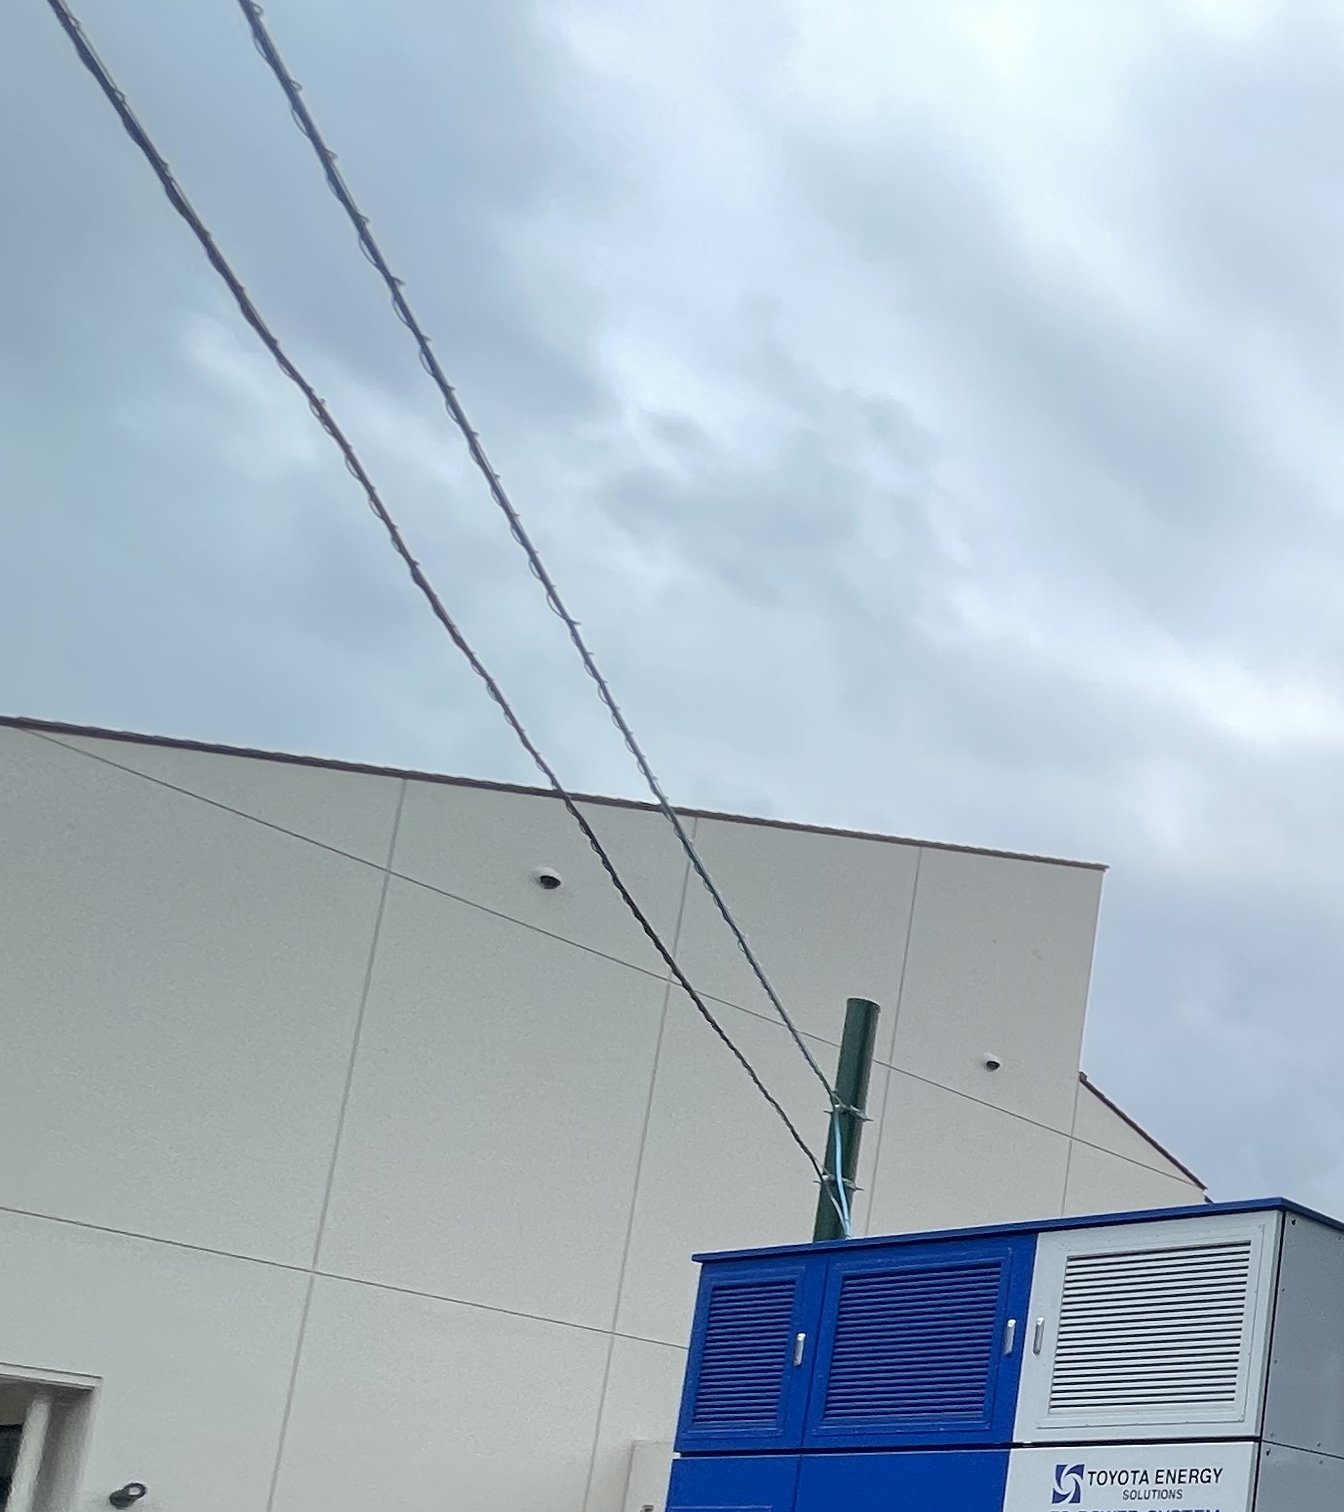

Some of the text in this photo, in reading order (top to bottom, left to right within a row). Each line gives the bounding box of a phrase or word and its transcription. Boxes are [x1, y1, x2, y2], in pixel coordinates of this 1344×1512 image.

[1088, 1468, 1223, 1486] TOYOTA ENERGY
[1122, 1489, 1183, 1501] SOLUTIONS
